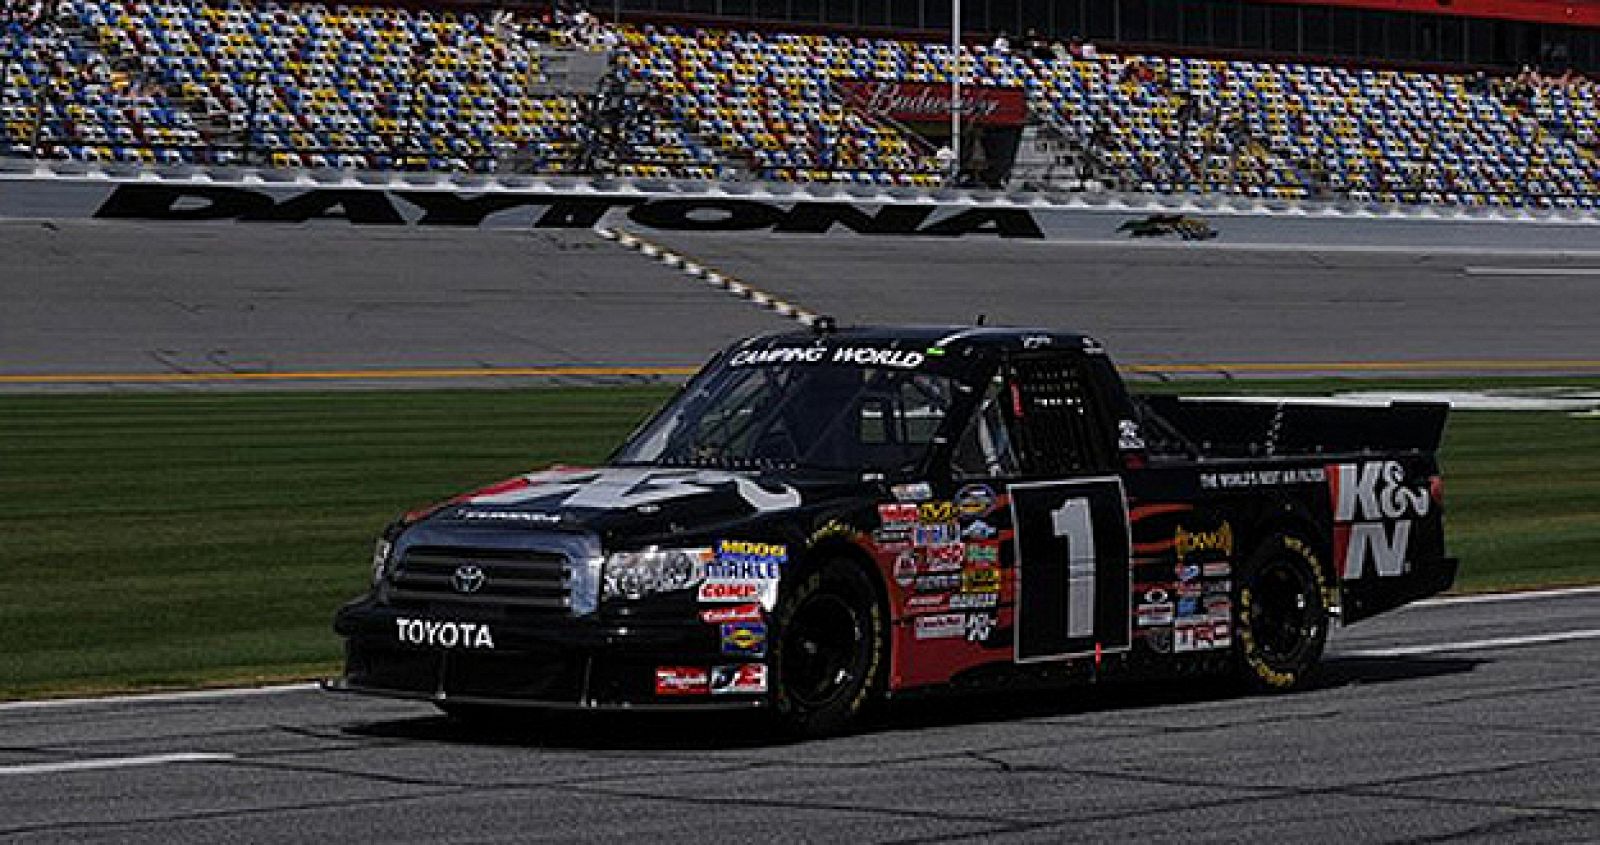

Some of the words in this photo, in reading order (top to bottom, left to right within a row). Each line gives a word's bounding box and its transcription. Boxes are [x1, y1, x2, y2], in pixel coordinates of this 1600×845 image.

[92, 183, 1046, 239] DAYTONA
[729, 345, 829, 367] CAMPING
[832, 346, 925, 368] WORLD
[721, 540, 787, 557] MOOG
[1050, 497, 1098, 639] 1
[701, 583, 757, 598] COMP
[396, 617, 495, 650] TOYOTA
